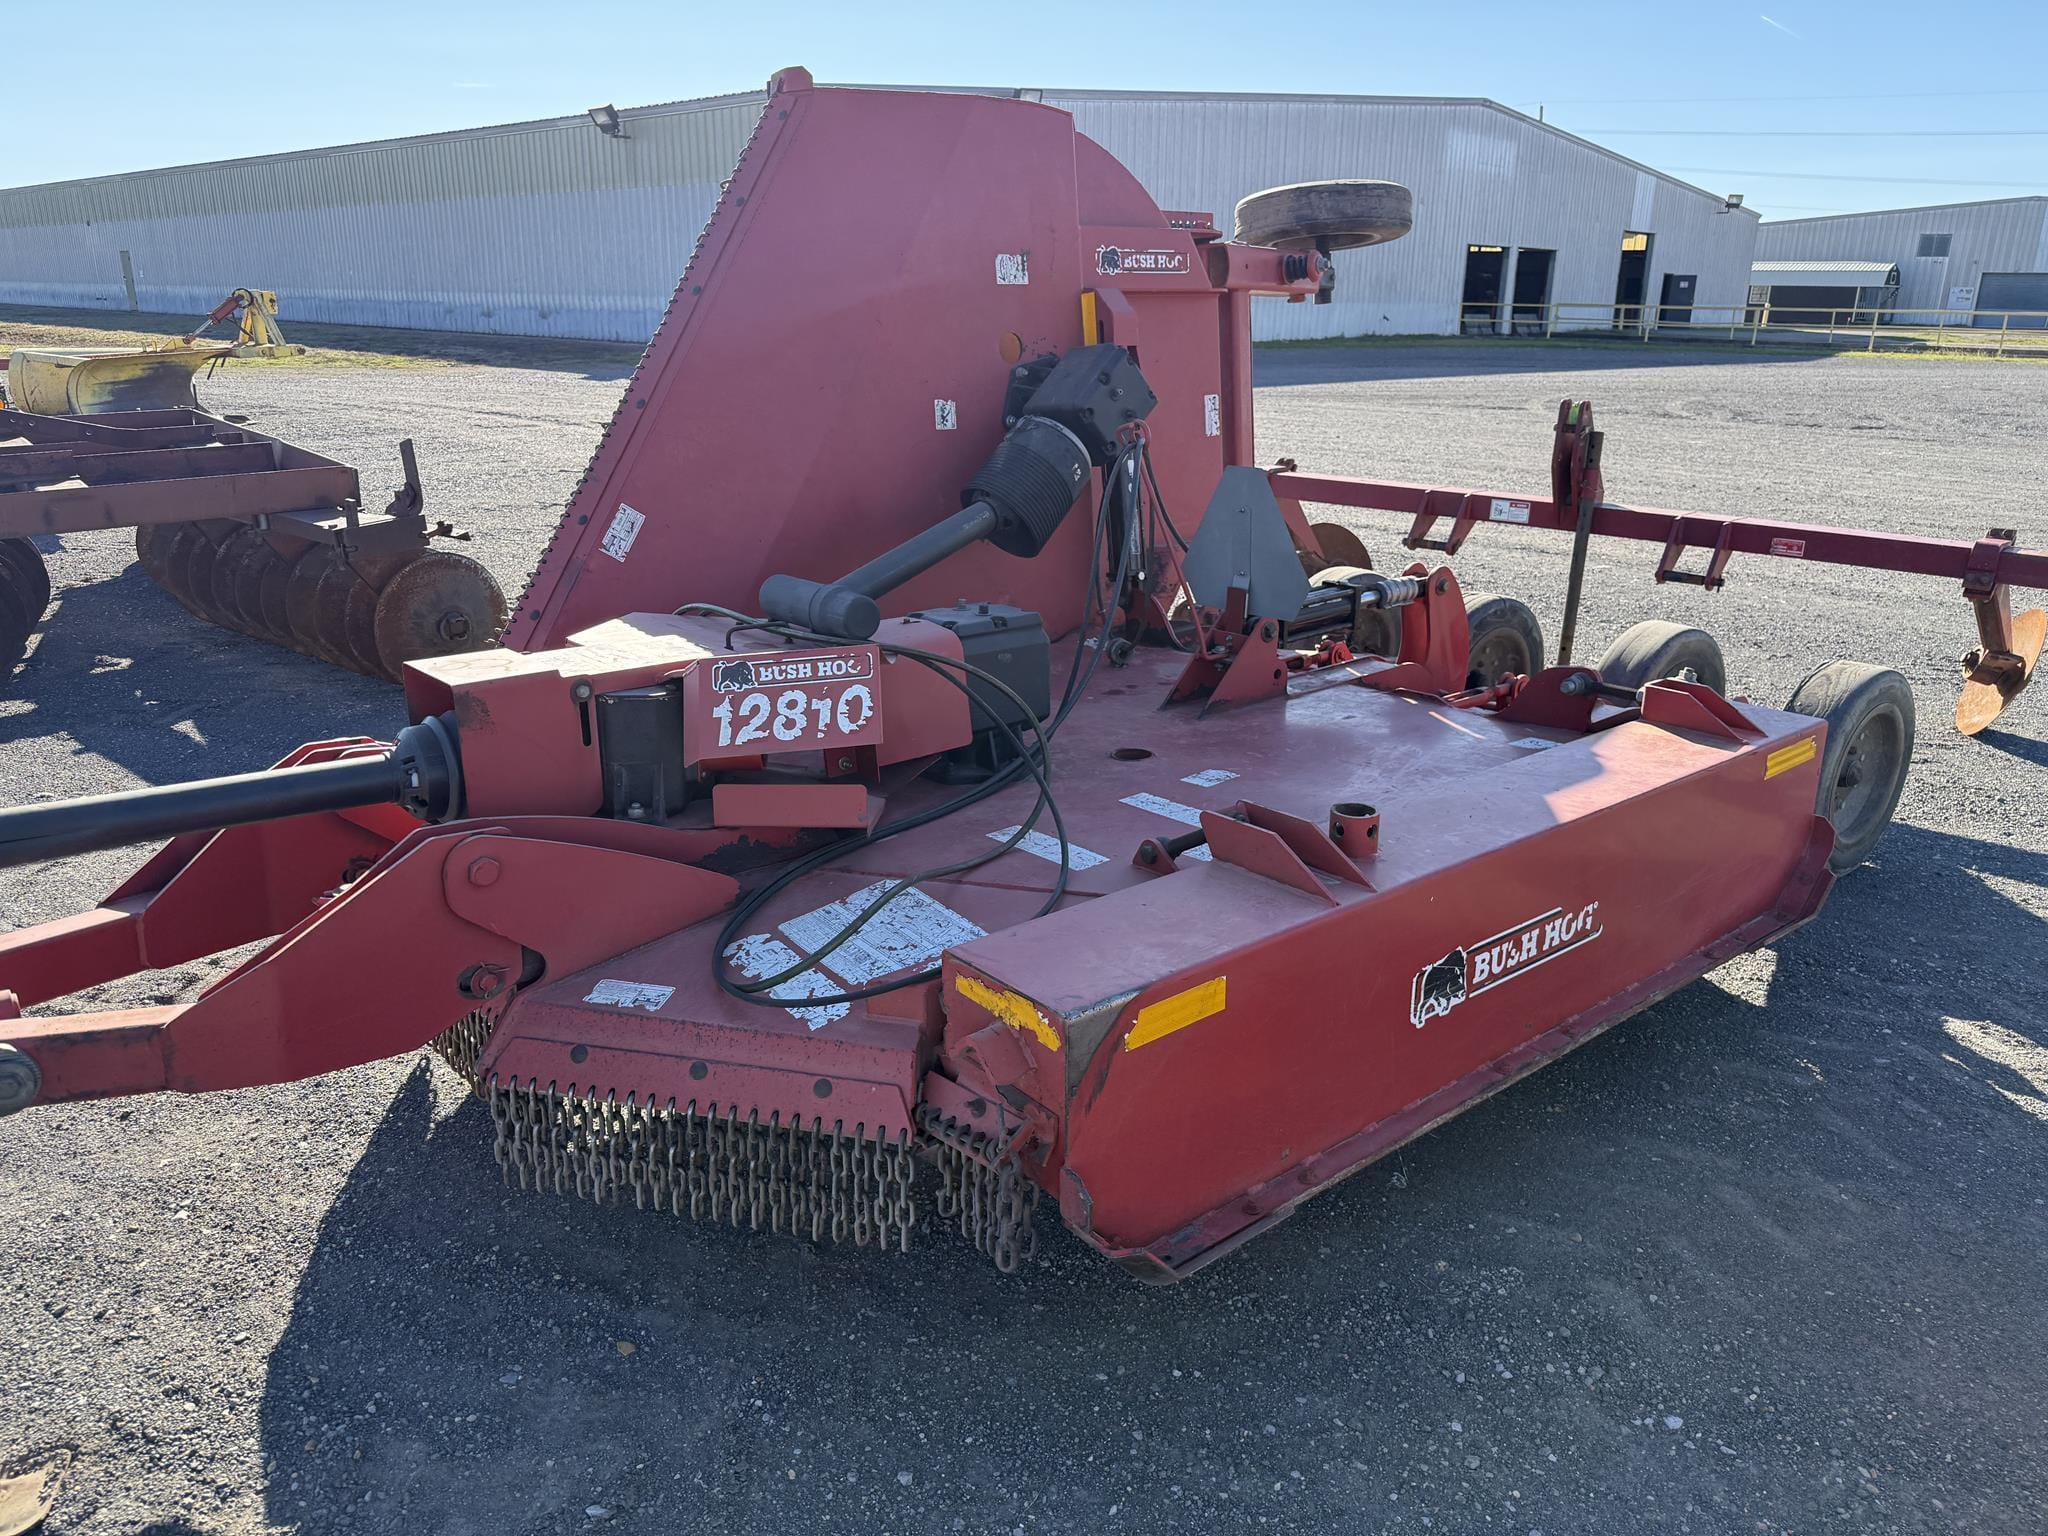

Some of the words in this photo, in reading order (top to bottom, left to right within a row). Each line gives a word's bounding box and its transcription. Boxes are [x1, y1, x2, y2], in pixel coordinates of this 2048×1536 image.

[1124, 254, 1155, 268] BUSH
[759, 662, 813, 682] BUSH
[713, 684, 874, 747] 12810
[1472, 928, 1540, 984] BUSH
[1543, 903, 1594, 951] HOG
